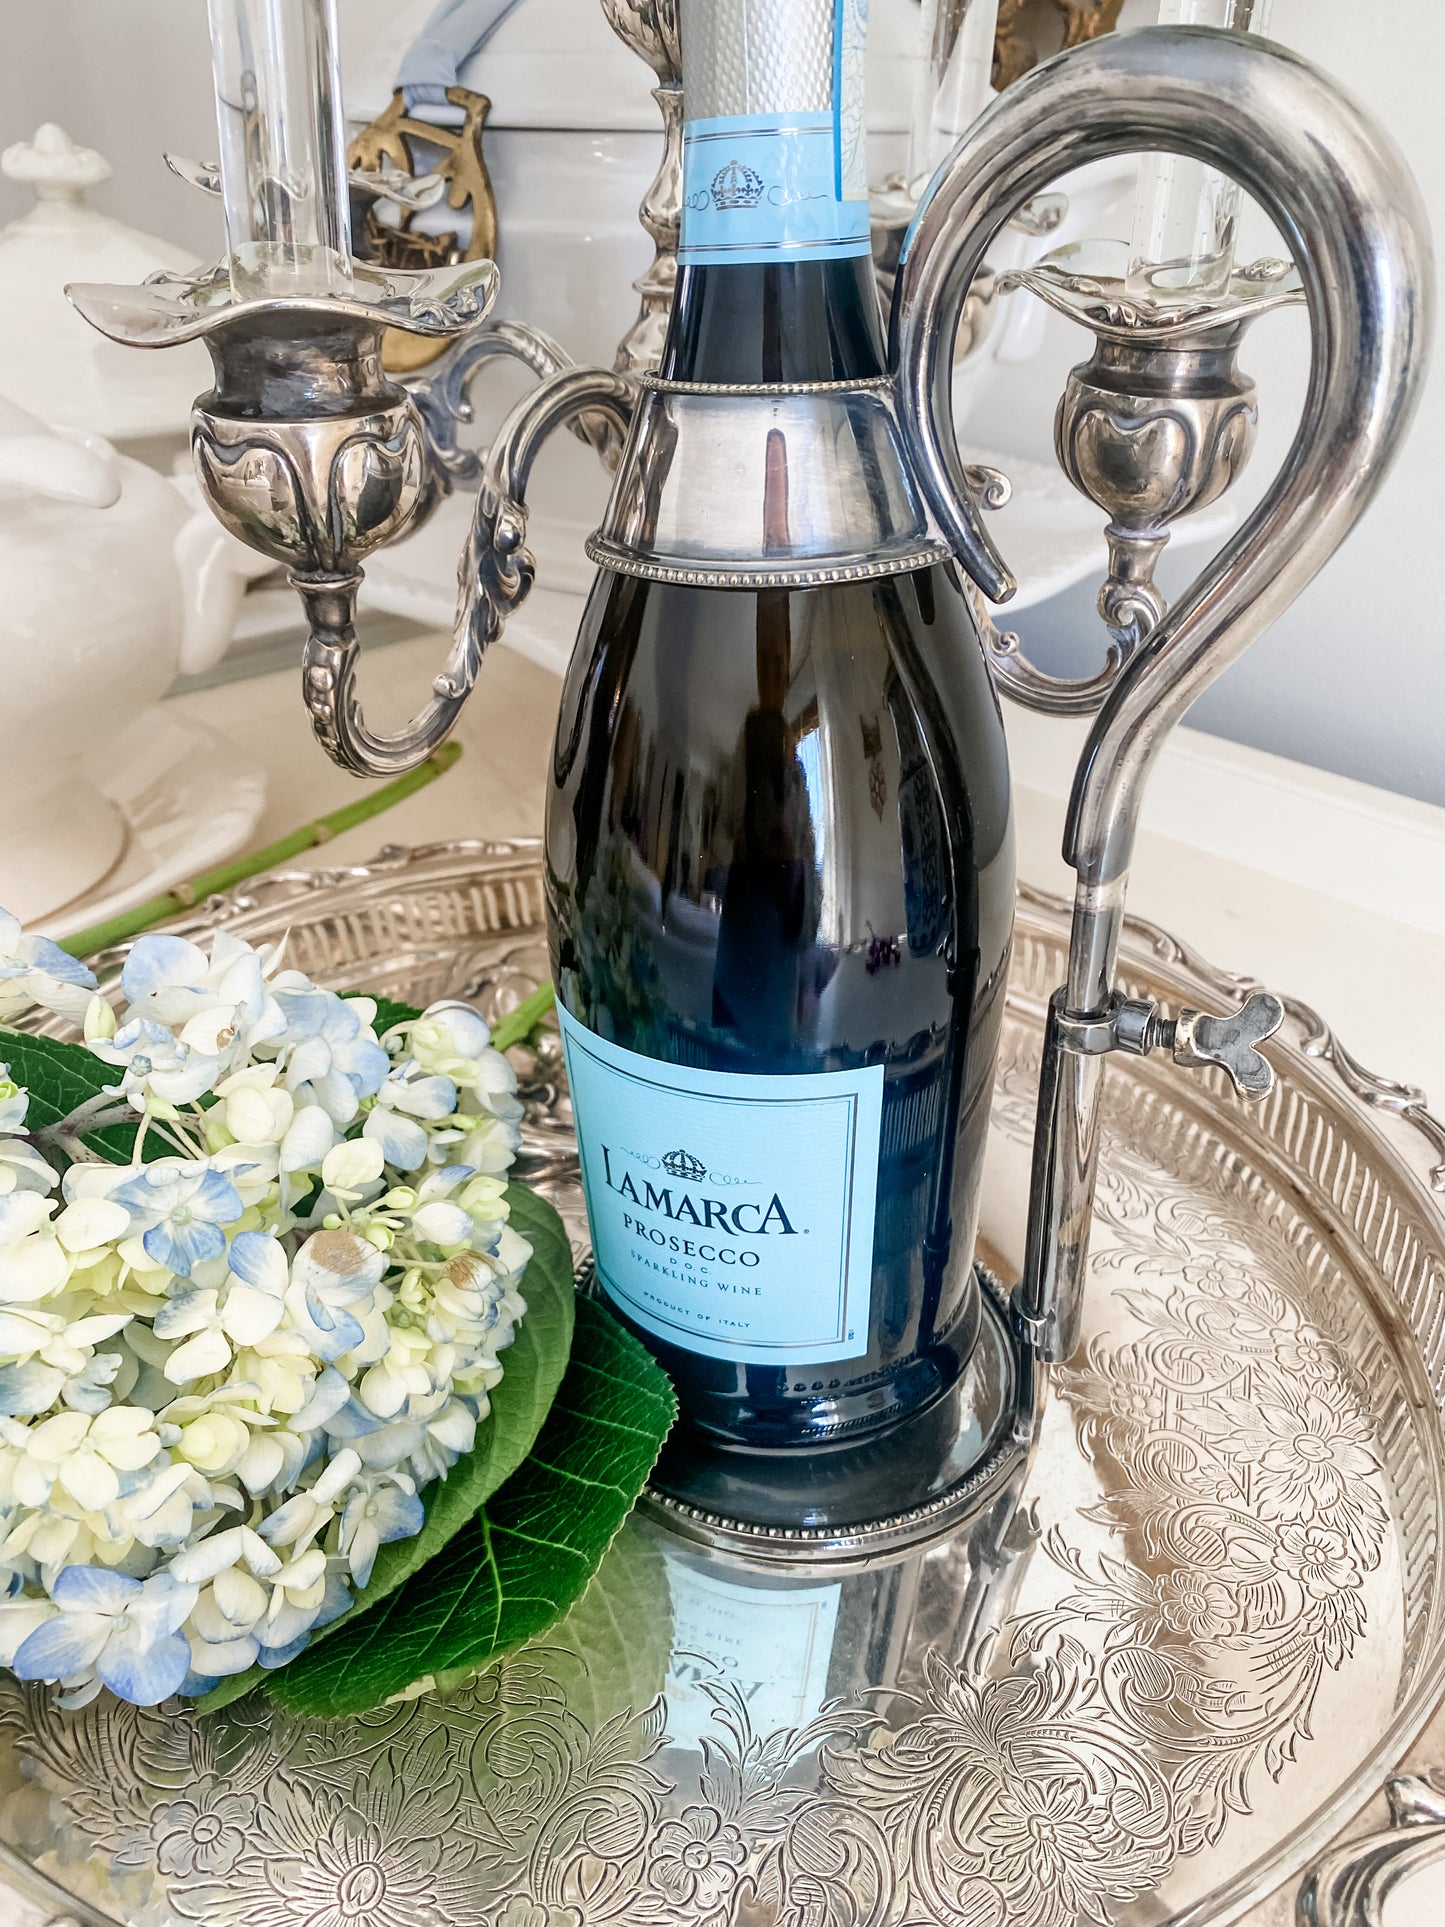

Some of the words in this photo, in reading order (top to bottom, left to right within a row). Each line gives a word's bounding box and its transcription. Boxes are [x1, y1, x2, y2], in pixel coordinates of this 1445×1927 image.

[623, 1212, 760, 1267] PROSECCO
[630, 1250, 709, 1288] SPARKLING
[717, 1282, 762, 1296] WINE
[643, 1291, 690, 1315] PRODUCT
[696, 1313, 711, 1321] OF
[718, 1318, 750, 1328] ITALY
